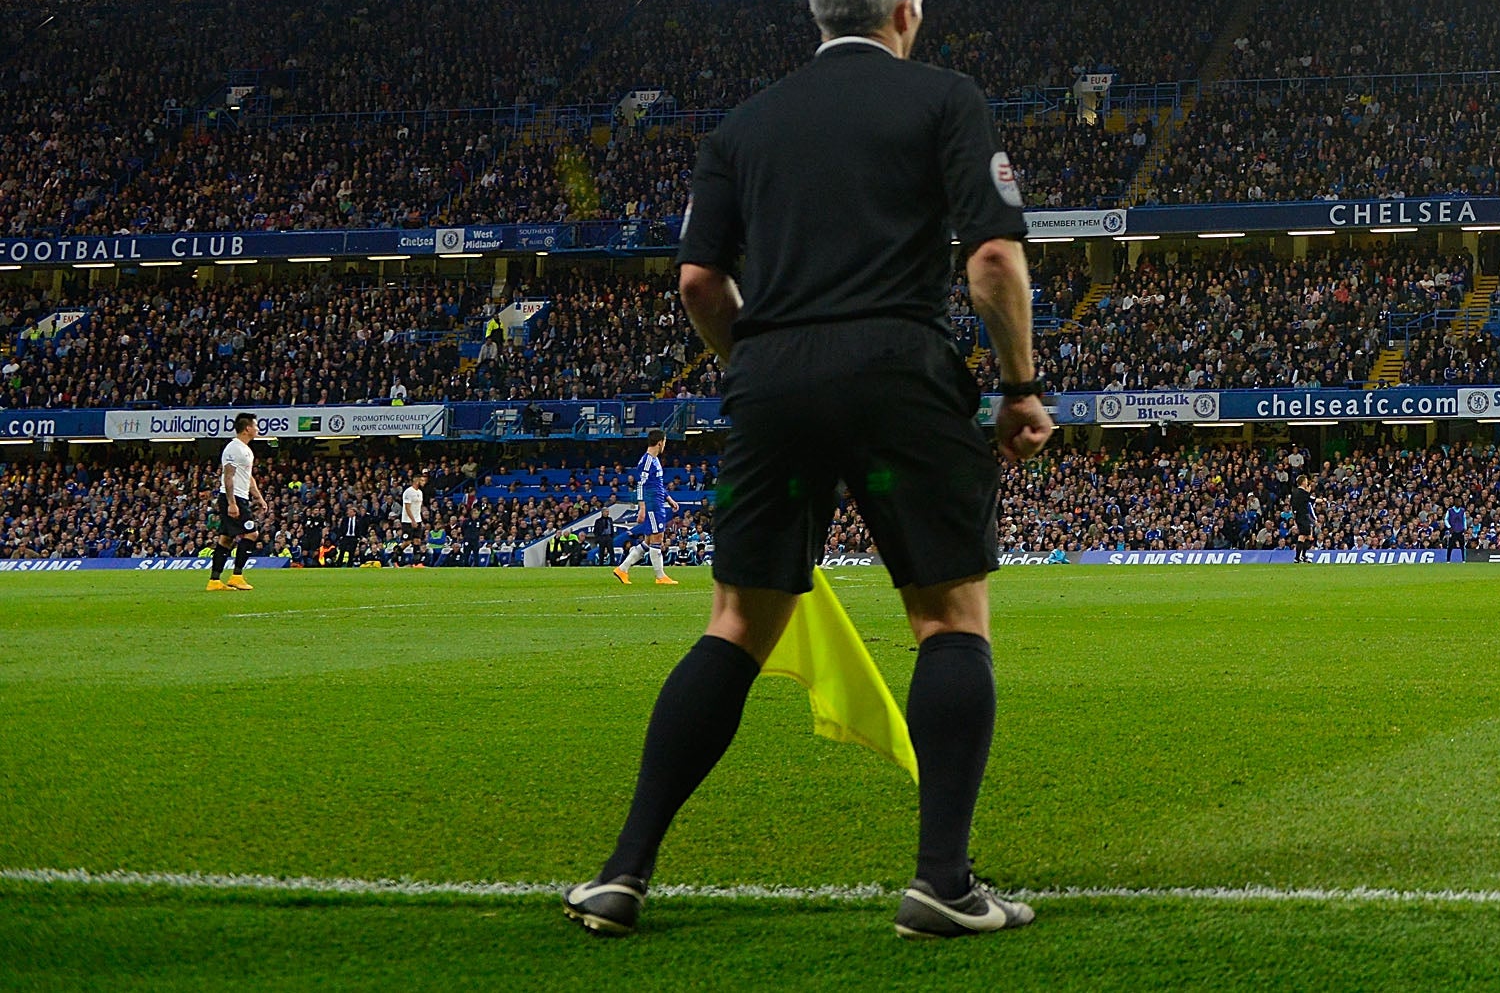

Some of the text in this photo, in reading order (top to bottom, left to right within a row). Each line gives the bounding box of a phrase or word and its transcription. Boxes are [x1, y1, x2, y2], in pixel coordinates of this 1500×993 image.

[1329, 201, 1476, 226] CHELSEA
[1031, 219, 1076, 228] REMEMBER
[1077, 219, 1100, 227] THEM
[473, 230, 493, 239] West
[171, 236, 244, 257] CLUB
[400, 237, 434, 247] Chelsea
[465, 239, 500, 249] Midlands
[522, 305, 535, 313] EM
[1125, 393, 1190, 407] Dundalk
[1256, 392, 1457, 417] chelseafc.com
[352, 413, 431, 422] PROMOTING EQUALITY
[1137, 407, 1178, 419] Blues
[150, 415, 220, 436] building
[360, 423, 377, 431] OUR
[1108, 553, 1242, 565] SAMSUNG
